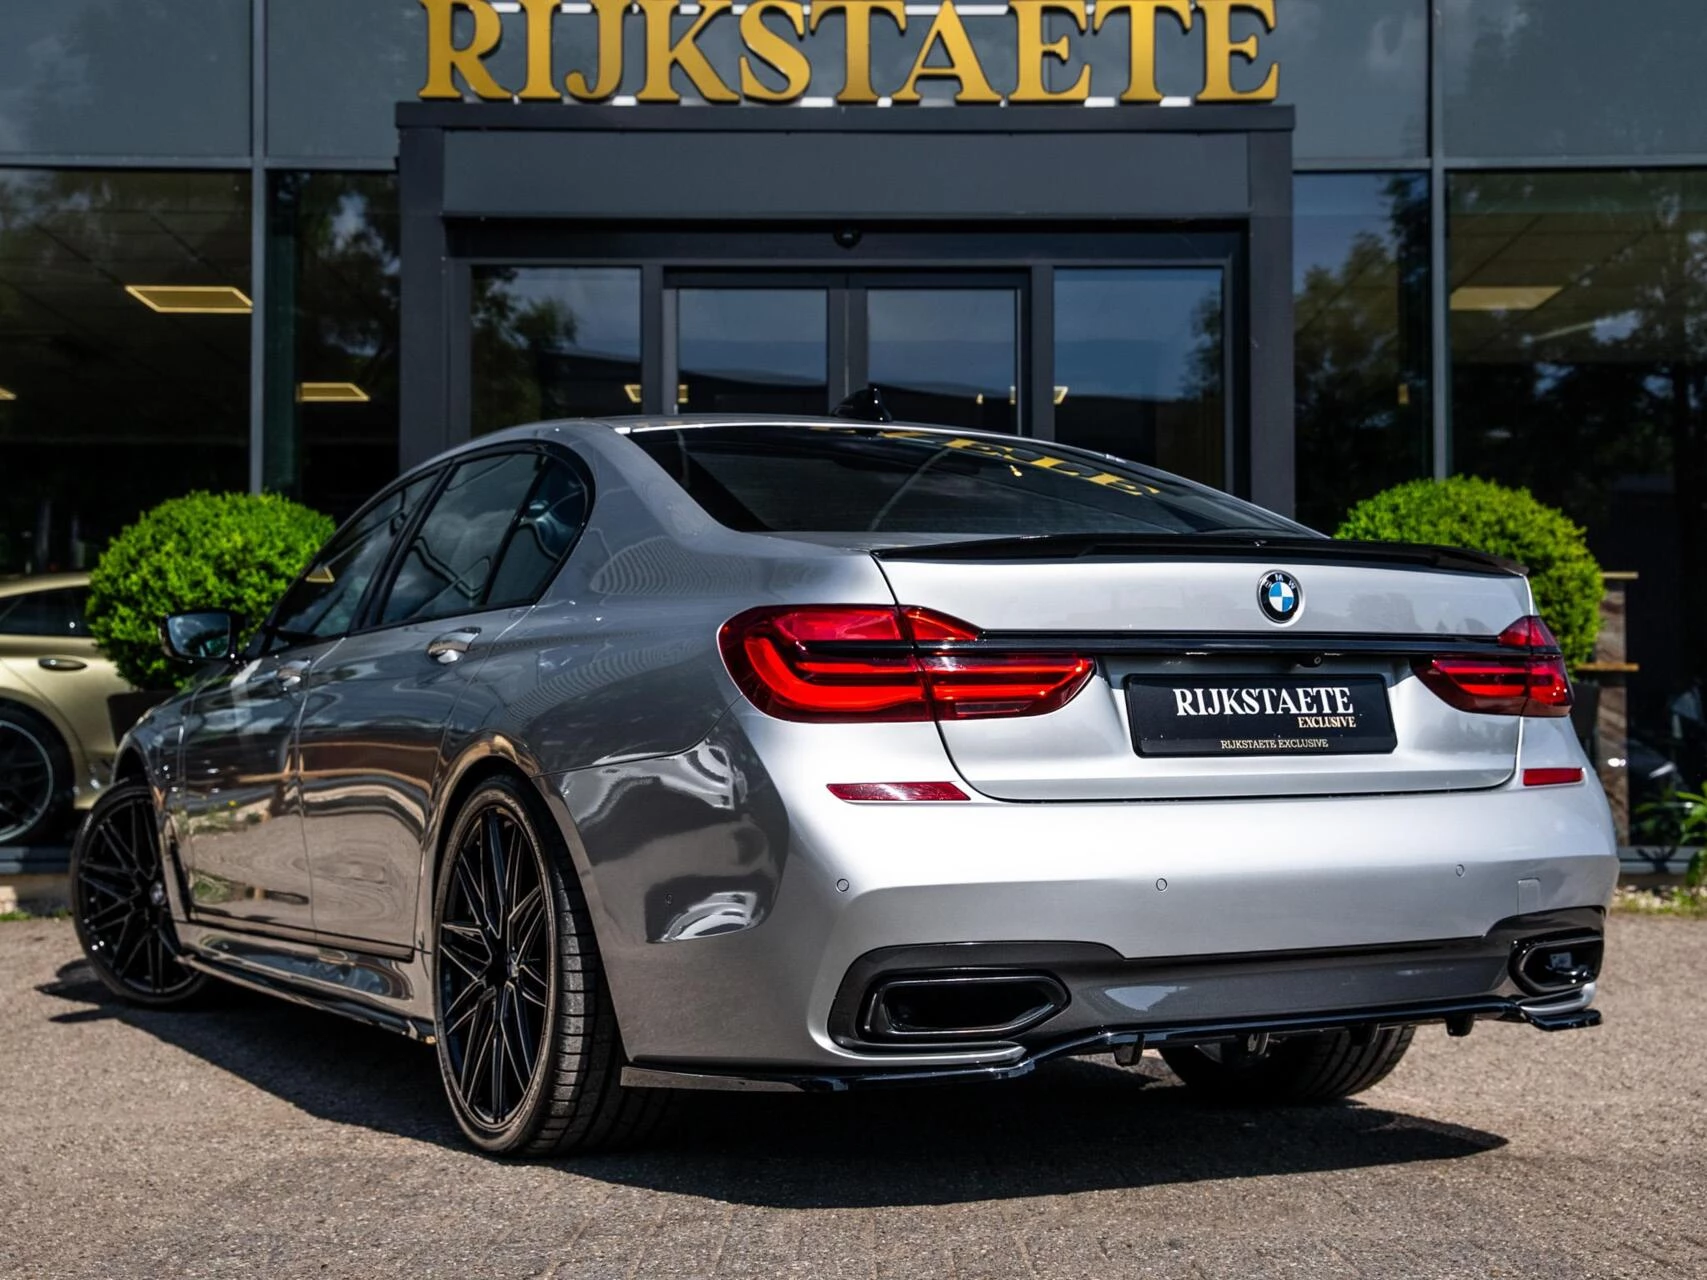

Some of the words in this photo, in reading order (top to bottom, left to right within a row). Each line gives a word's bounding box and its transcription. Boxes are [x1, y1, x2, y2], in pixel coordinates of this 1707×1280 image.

[418, 0, 1280, 103] RIJKSTAETE
[1264, 573, 1296, 589] BMW
[1173, 687, 1354, 716] RIJKSTAETE
[1298, 716, 1356, 728] EXCLUSIVE
[1221, 739, 1276, 749] RIJKSTAETE
[1278, 738, 1329, 748] EXCLUSIVE
